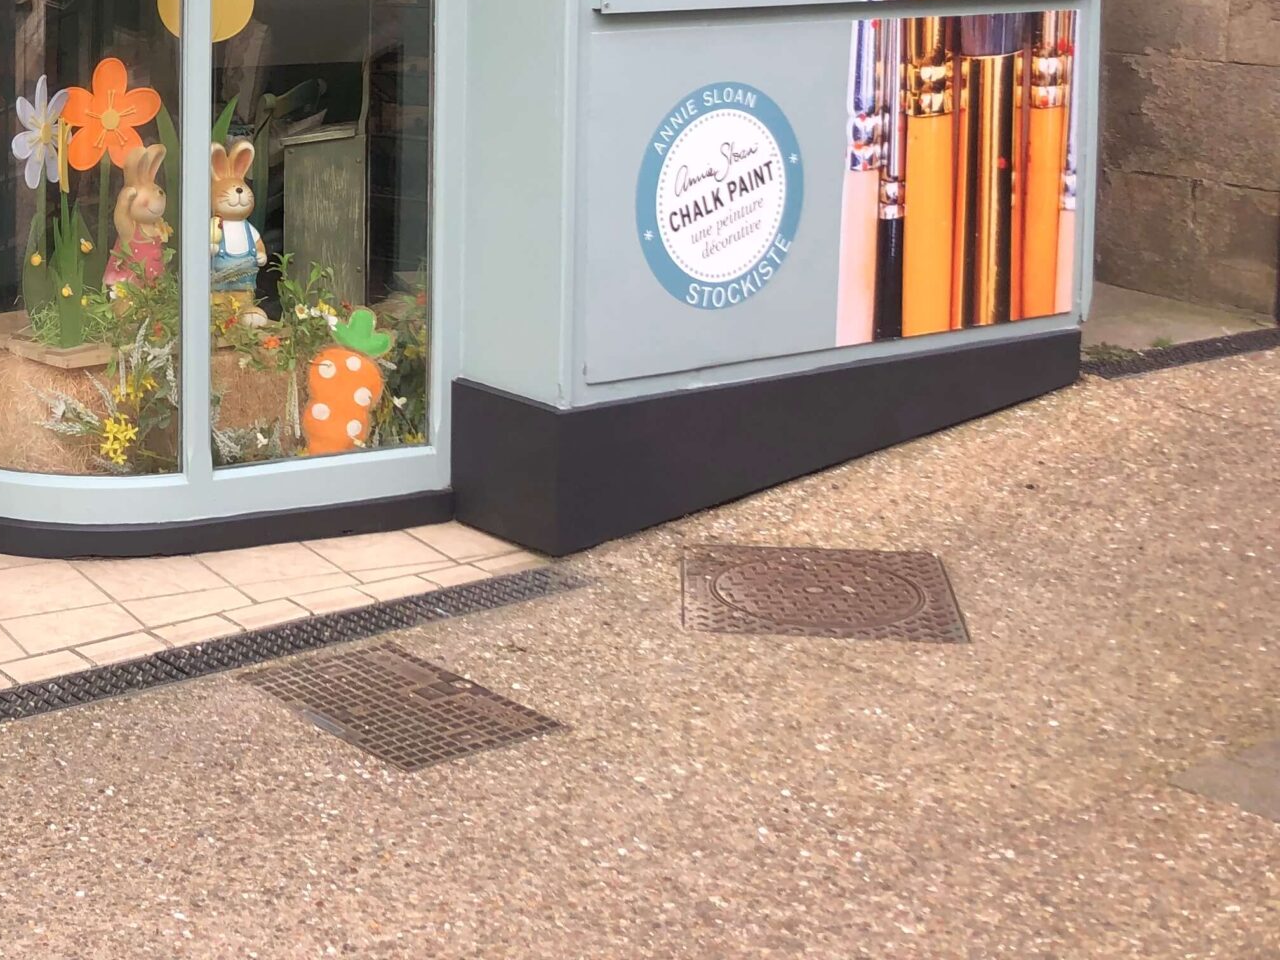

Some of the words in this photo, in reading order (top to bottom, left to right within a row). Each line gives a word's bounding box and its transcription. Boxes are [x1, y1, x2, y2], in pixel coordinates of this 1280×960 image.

[652, 98, 699, 156] ANNIE
[701, 87, 757, 109] SLOAN
[669, 186, 725, 233] CHALK
[726, 160, 775, 202] PAINT
[690, 224, 713, 245] une
[716, 197, 764, 236] peinture
[685, 232, 792, 308] STOCKISTE
[701, 217, 763, 260] décorative
